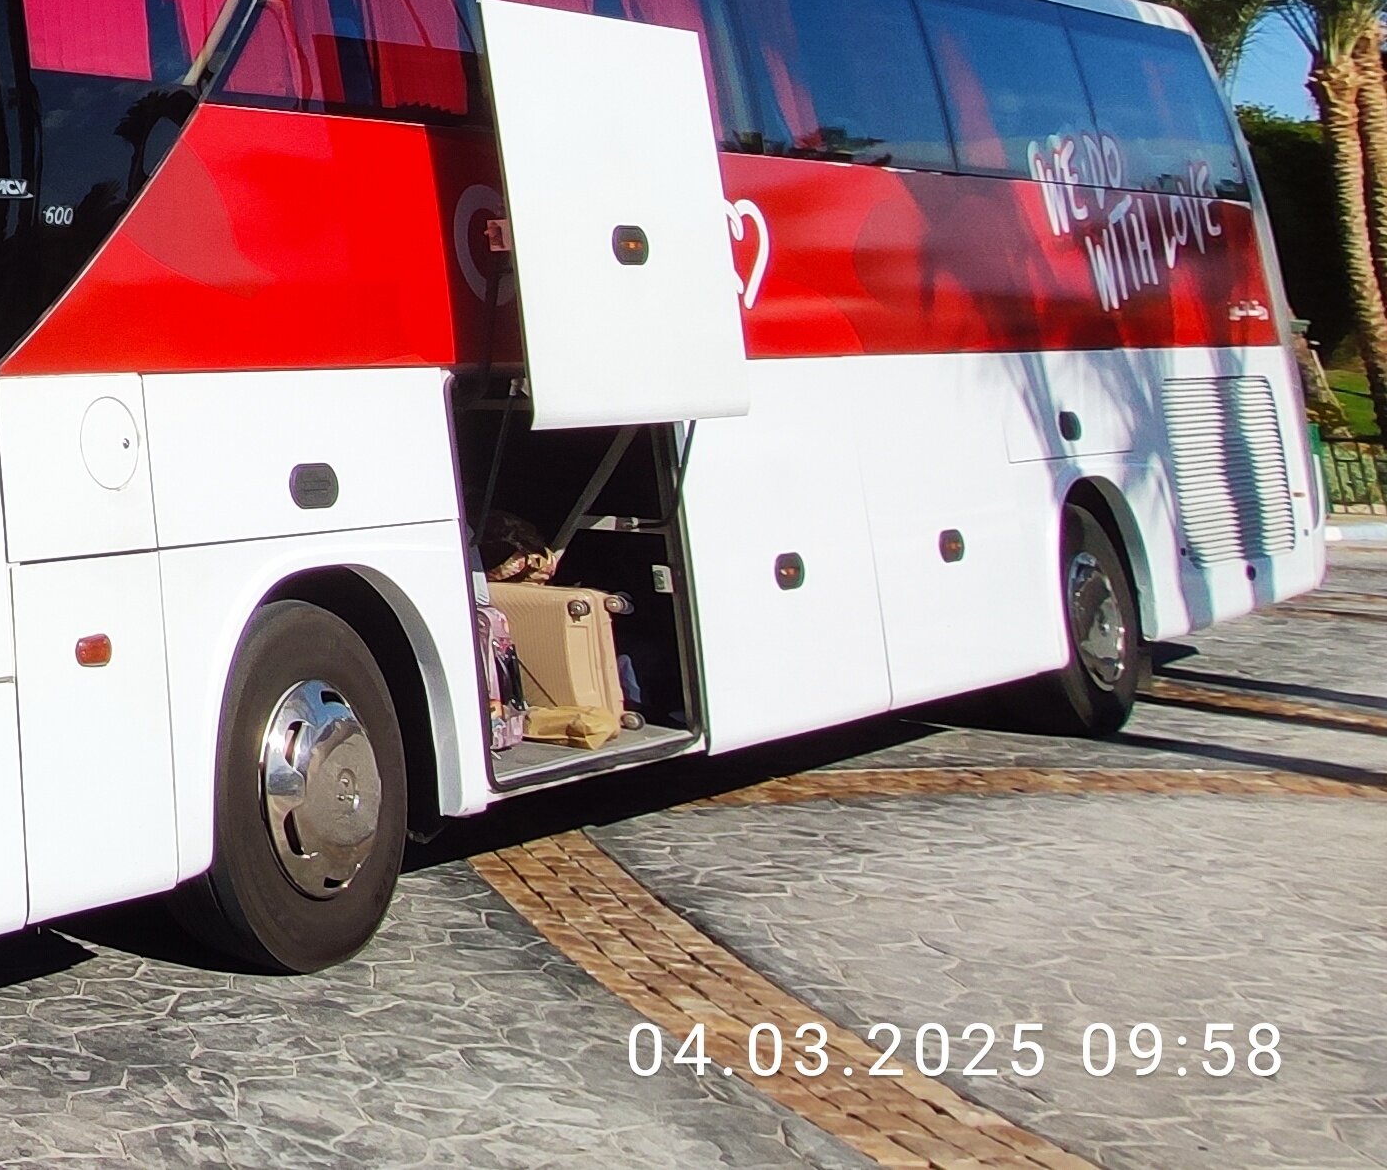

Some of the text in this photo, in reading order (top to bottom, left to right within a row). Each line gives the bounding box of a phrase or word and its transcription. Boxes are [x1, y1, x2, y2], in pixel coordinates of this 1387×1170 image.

[43, 205, 74, 225] 600
[1028, 133, 1089, 236] WE
[1084, 163, 1222, 312] WITH LOVE
